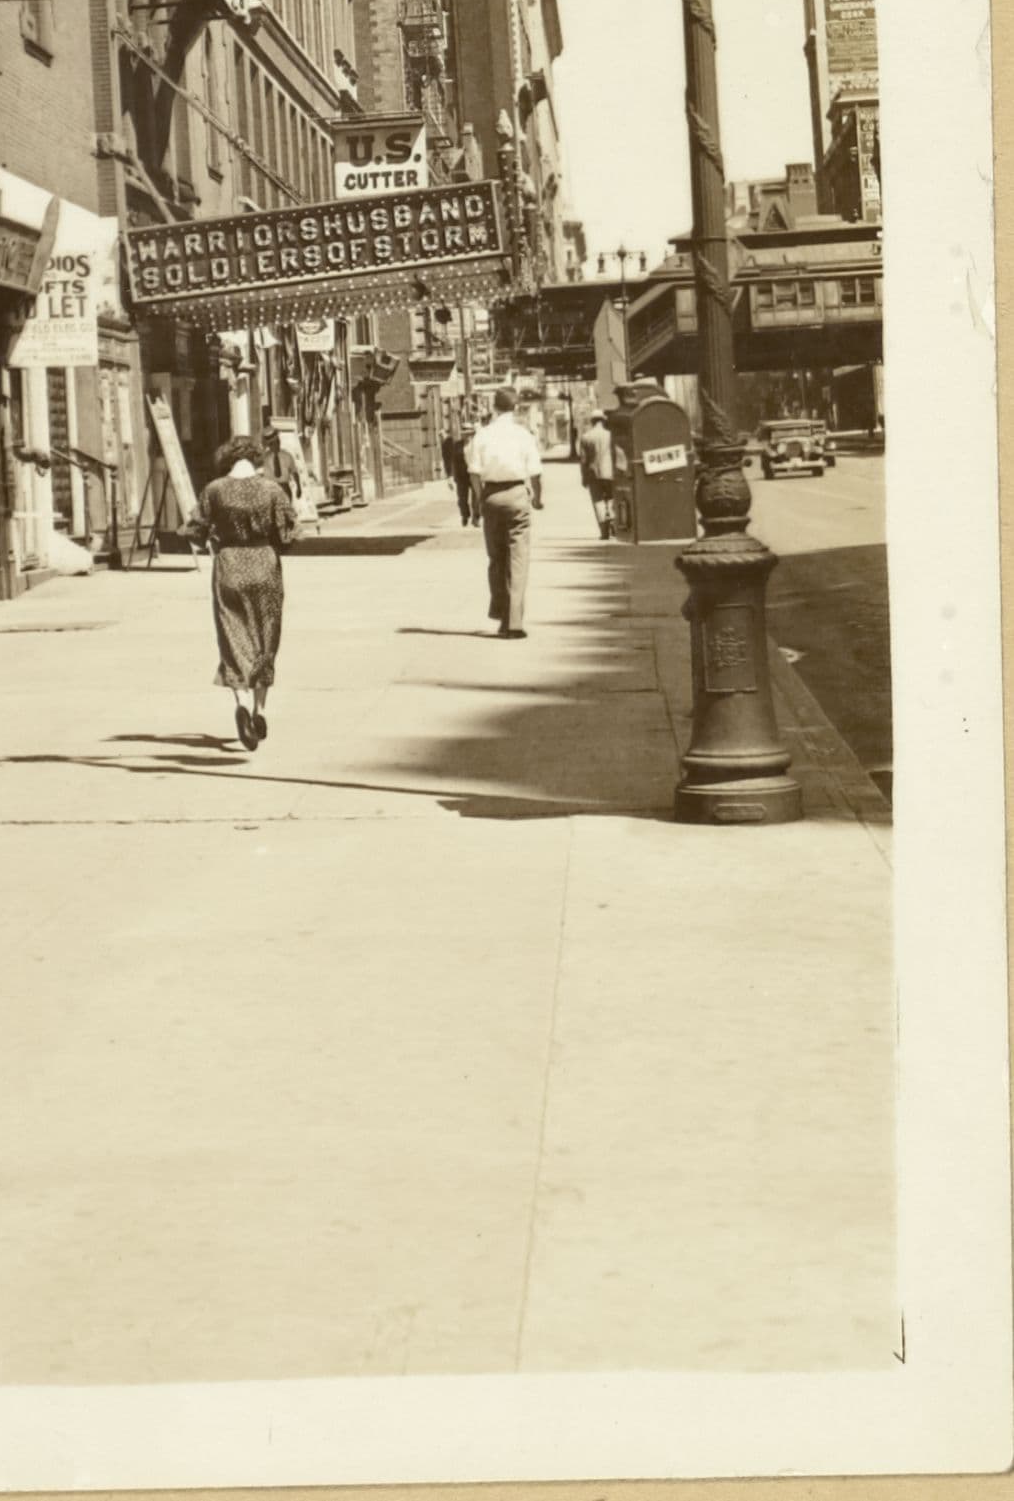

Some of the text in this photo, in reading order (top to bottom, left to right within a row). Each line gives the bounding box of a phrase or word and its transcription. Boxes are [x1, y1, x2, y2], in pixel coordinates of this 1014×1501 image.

[346, 133, 422, 167] U.S.
[343, 169, 418, 191] CUTTER
[48, 296, 88, 319] LET
